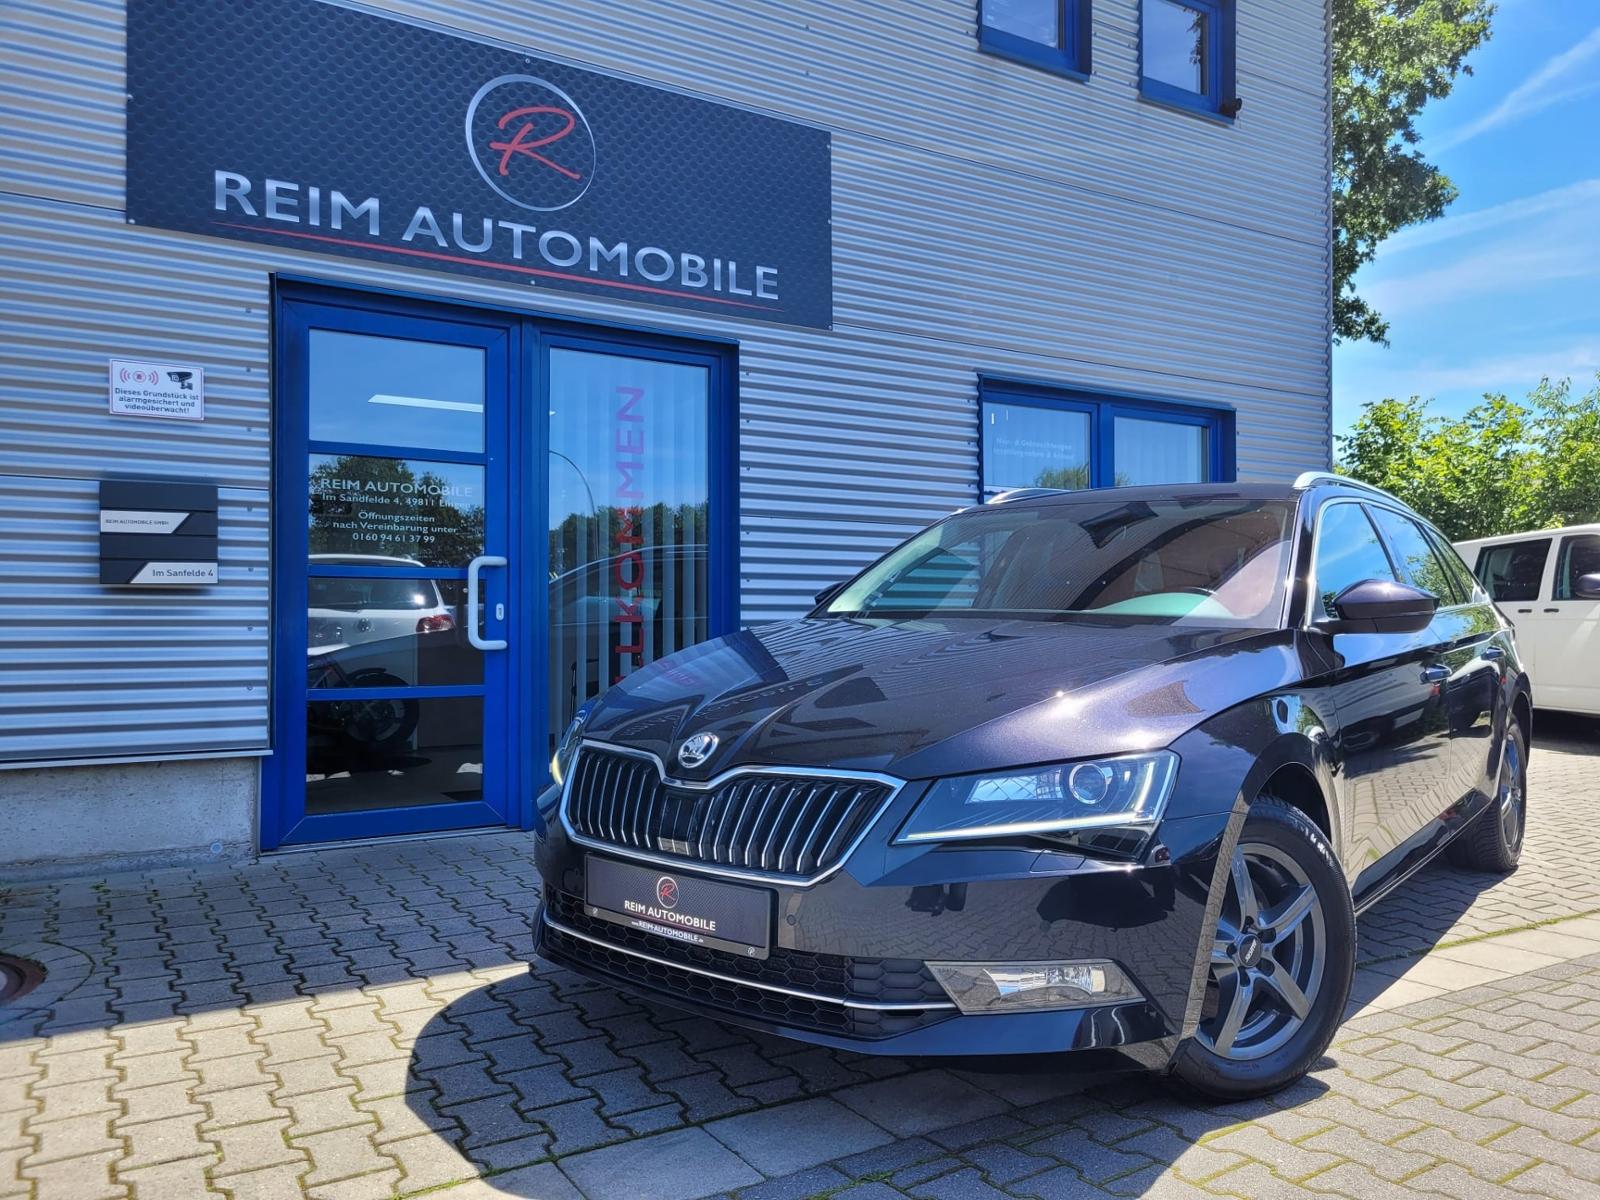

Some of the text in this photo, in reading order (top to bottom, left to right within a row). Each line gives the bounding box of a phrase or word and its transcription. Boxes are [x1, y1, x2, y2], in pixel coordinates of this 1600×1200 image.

[214, 168, 779, 301] REIM AUTOMOBILE
[115, 387, 141, 396] Dieses
[143, 389, 188, 400] Grundstück
[118, 396, 195, 408] alarmgesichert und
[124, 403, 190, 414] videoüberwacht!
[320, 478, 473, 498] REIM AUTOMOBILE
[322, 493, 336, 501] Im
[340, 494, 391, 505] Sandfelde
[405, 497, 434, 506] 49811
[358, 509, 435, 523] Öffnungszeiten
[332, 521, 358, 529] nach
[360, 521, 429, 534] Vereinbarung
[352, 532, 378, 541] 0160
[380, 533, 392, 541] 94
[152, 568, 213, 577] Im Sanfelde 4
[624, 899, 716, 931] REIM AUTOMOBILE
